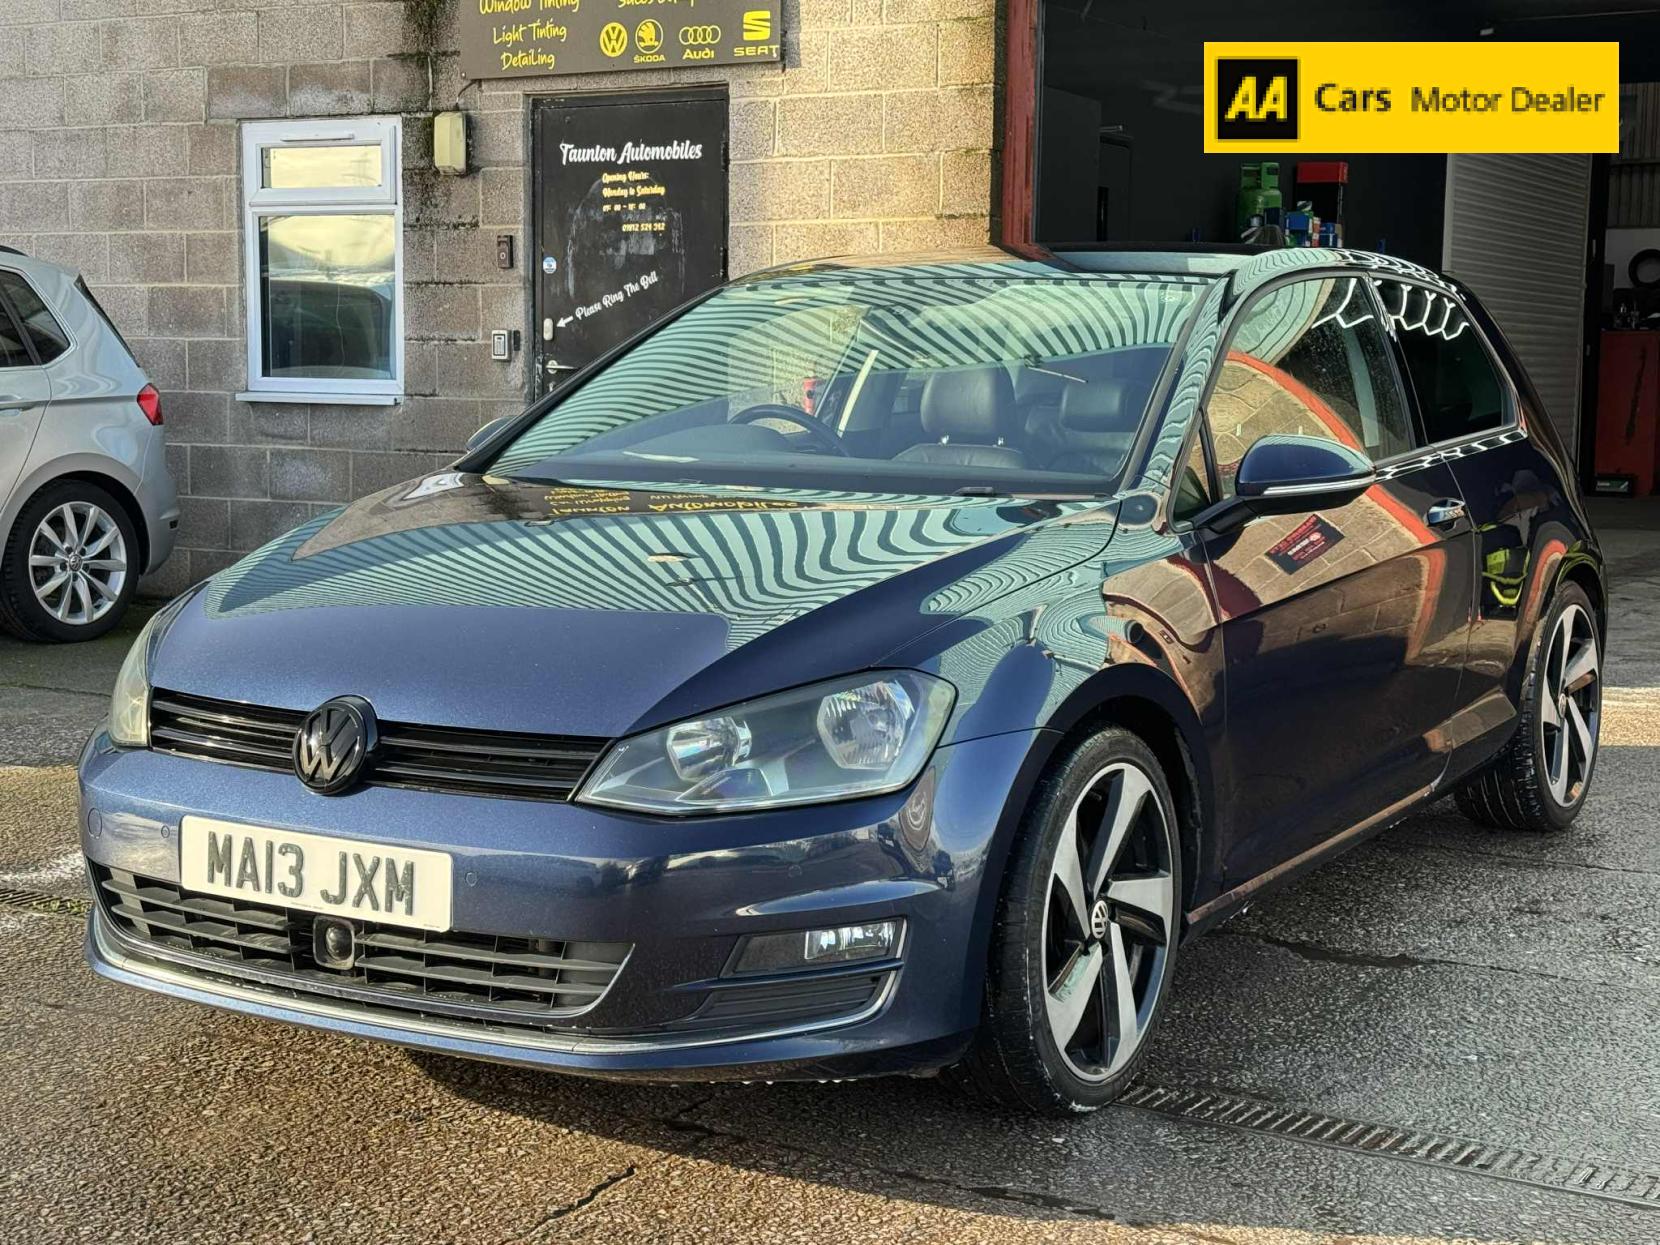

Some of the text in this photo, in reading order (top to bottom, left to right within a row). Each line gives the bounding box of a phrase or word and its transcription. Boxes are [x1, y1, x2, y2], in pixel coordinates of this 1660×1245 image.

[493, 18, 567, 48] Light Tinting
[501, 48, 556, 70] Detailing
[633, 54, 666, 64] ŠKODA
[682, 48, 715, 60] Audi
[733, 45, 780, 57] SEAT
[559, 139, 703, 166] Taunton Automobiles
[575, 270, 659, 321] Please Ring The Bell
[207, 830, 415, 917] MA13 JXM
